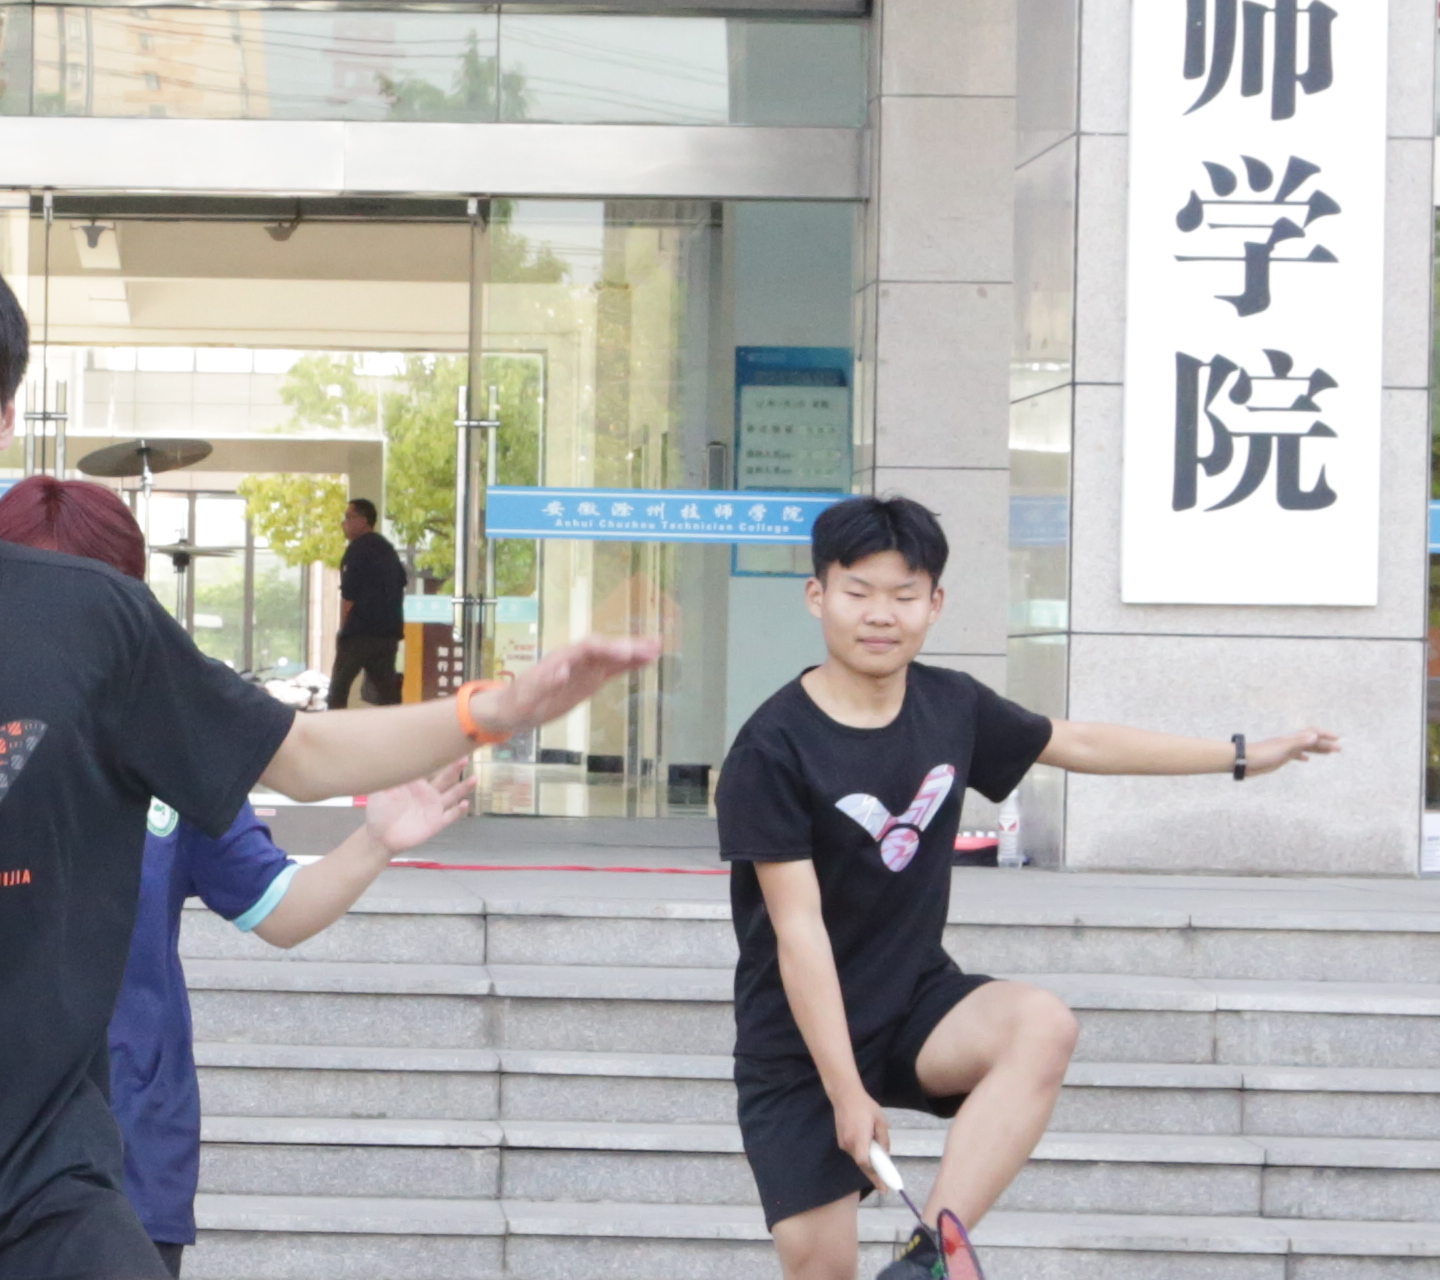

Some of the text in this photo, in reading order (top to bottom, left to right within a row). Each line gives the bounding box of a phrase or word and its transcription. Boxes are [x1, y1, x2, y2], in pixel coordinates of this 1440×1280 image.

[542, 500, 804, 522] 安徽滁州技师学院
[555, 518, 790, 534] Anhui Chuzhou Technician College
